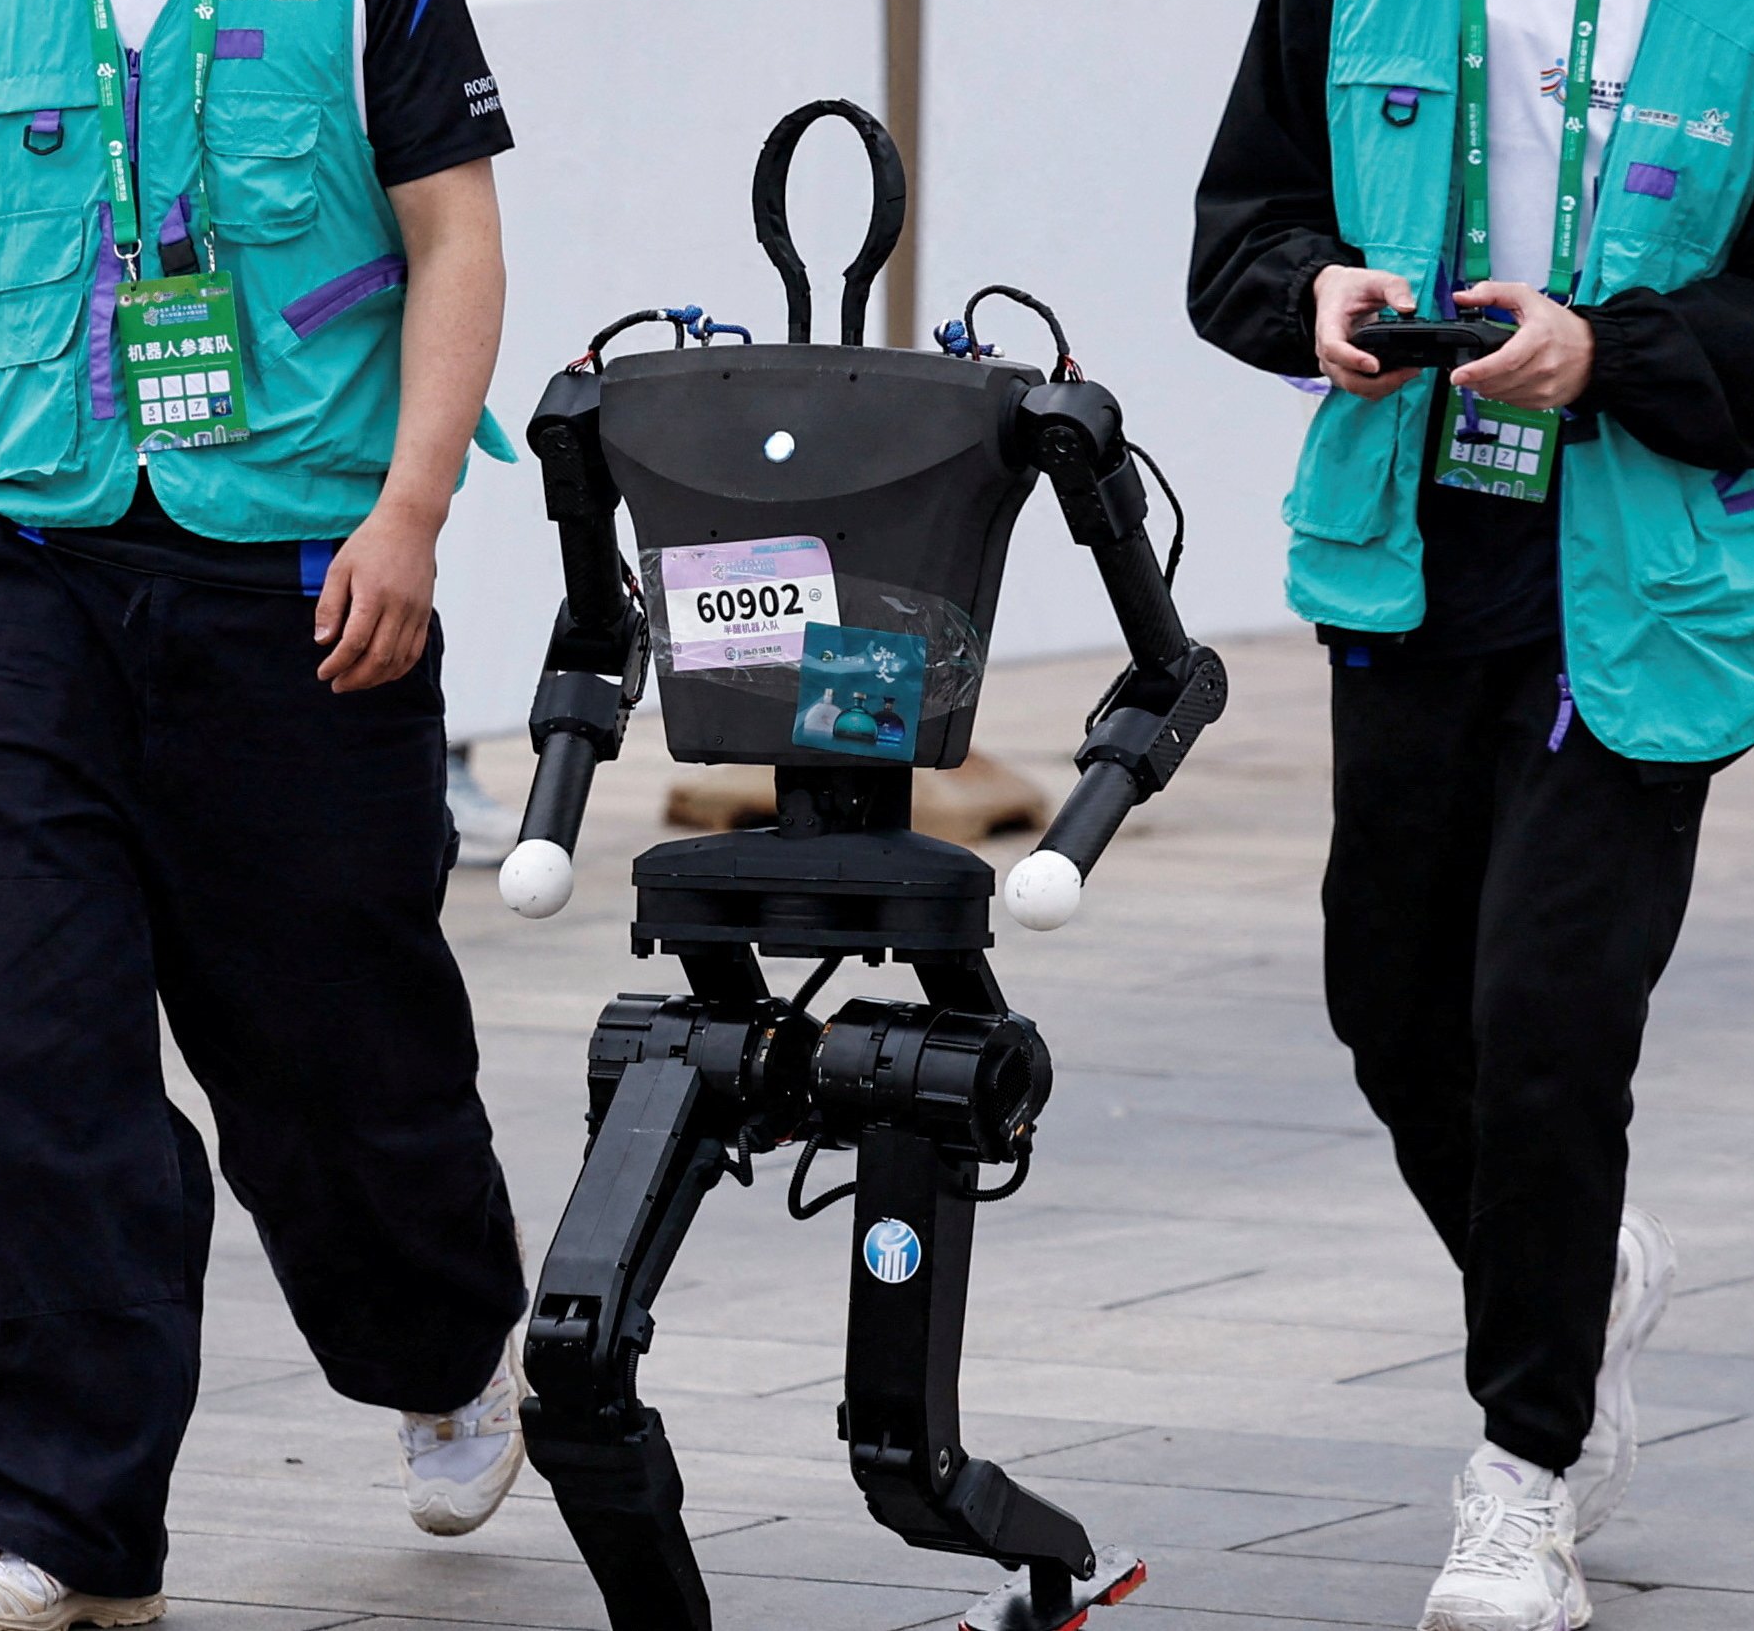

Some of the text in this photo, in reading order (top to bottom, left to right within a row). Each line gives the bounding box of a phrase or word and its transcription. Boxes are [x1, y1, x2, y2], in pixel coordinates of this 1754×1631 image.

[128, 334, 233, 362] 机器人参赛队
[148, 405, 156, 416] 5
[171, 403, 179, 414] 6
[194, 401, 201, 411] 7
[697, 583, 804, 623] 60902
